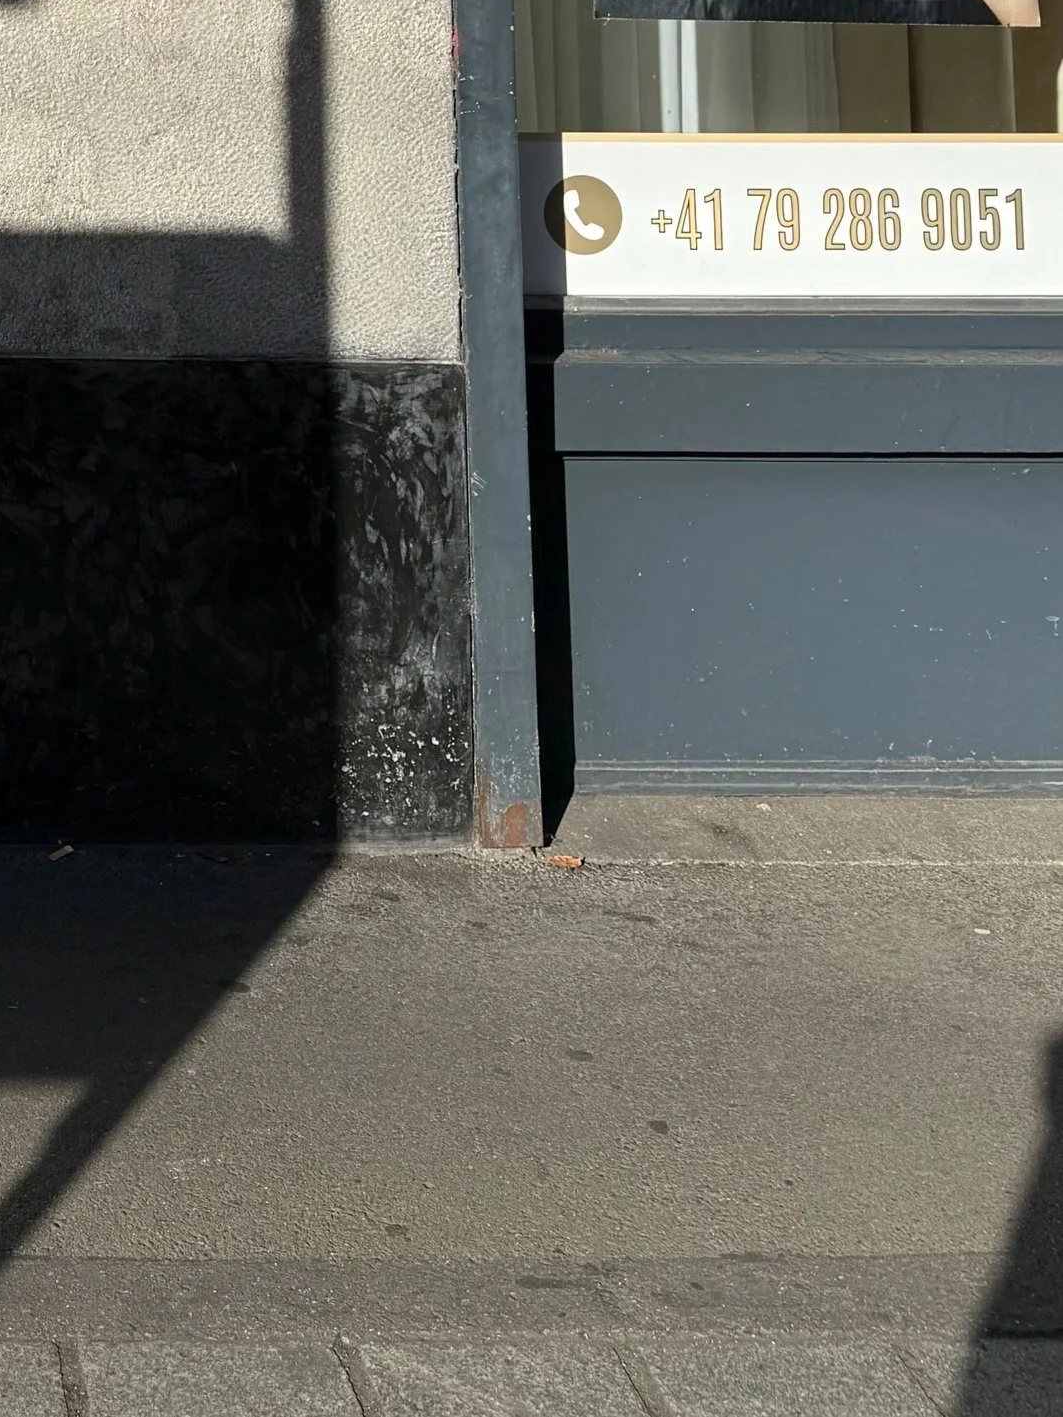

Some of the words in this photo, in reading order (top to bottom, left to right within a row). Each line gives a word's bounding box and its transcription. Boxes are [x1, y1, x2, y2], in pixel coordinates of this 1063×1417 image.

[650, 188, 724, 251] +41
[746, 188, 801, 251] 79
[823, 188, 901, 251] 286
[921, 188, 1026, 251] 9051
